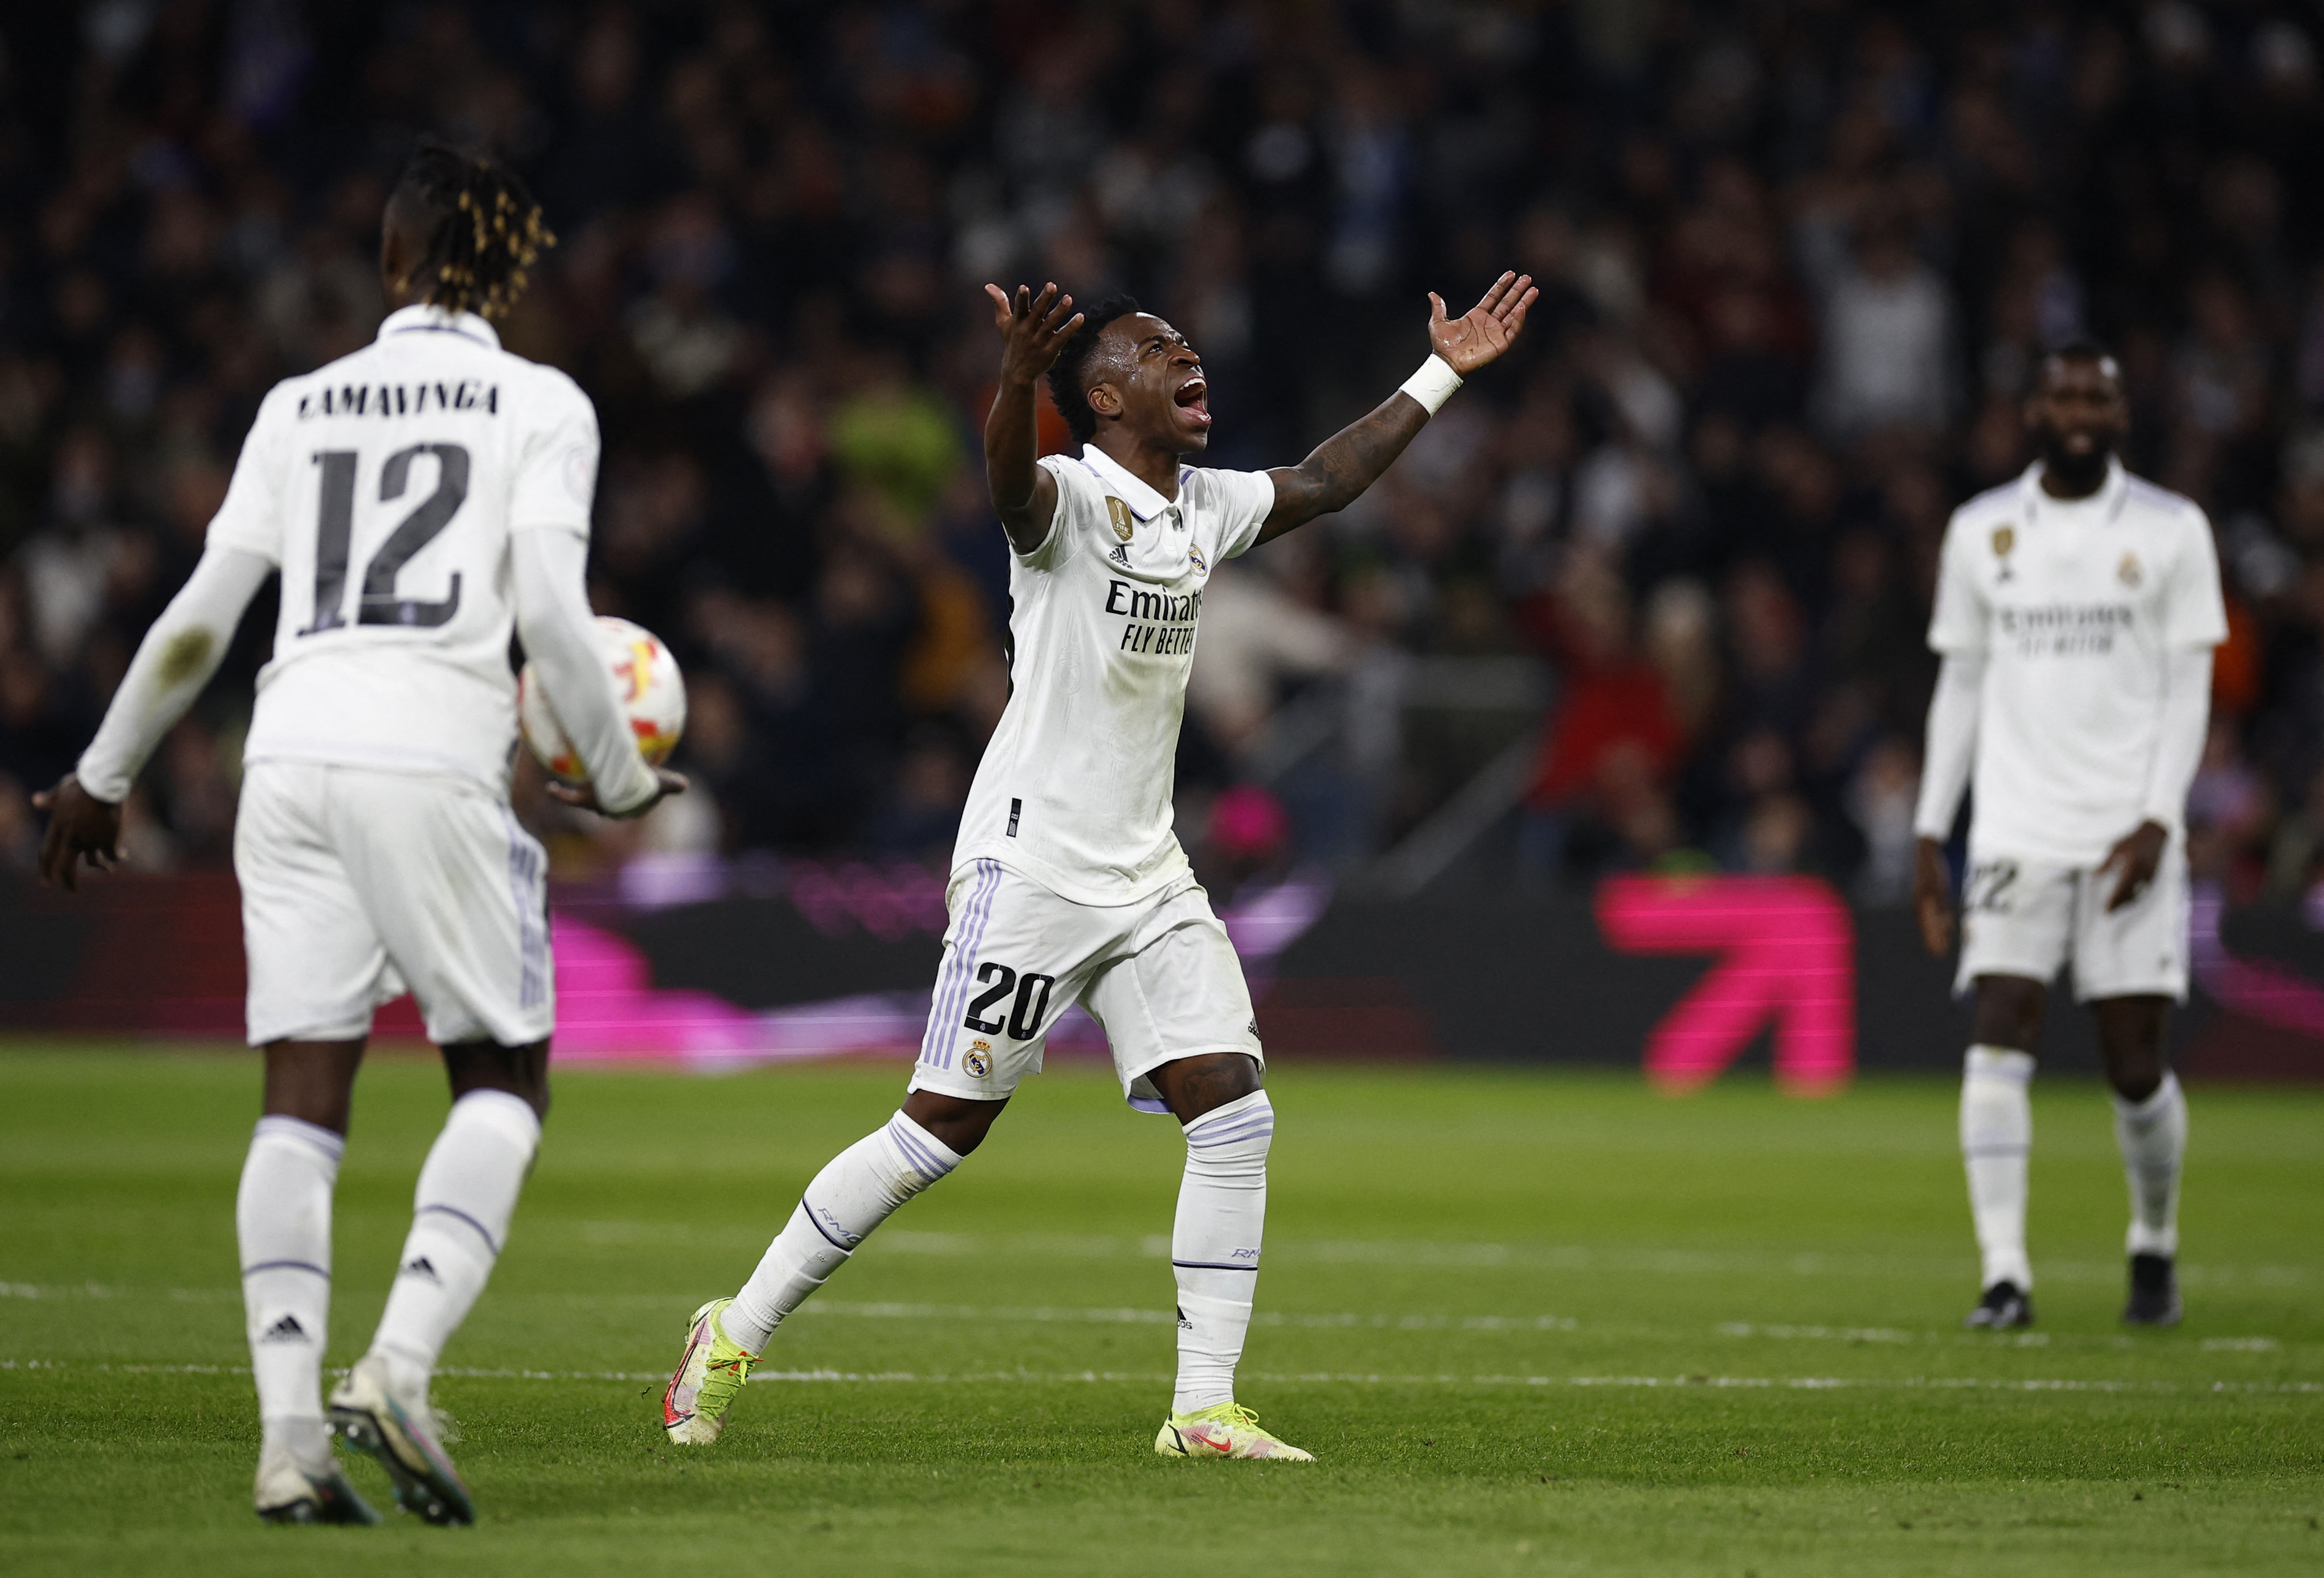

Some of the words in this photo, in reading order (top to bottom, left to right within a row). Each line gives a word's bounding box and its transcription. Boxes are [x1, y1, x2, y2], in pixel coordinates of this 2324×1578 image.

[295, 442, 470, 637] 12
[1115, 522, 1129, 533] FIFA
[1121, 624, 1155, 653] FLY
[1155, 626, 1195, 655] BETTE
[964, 962, 1055, 1041] 20
